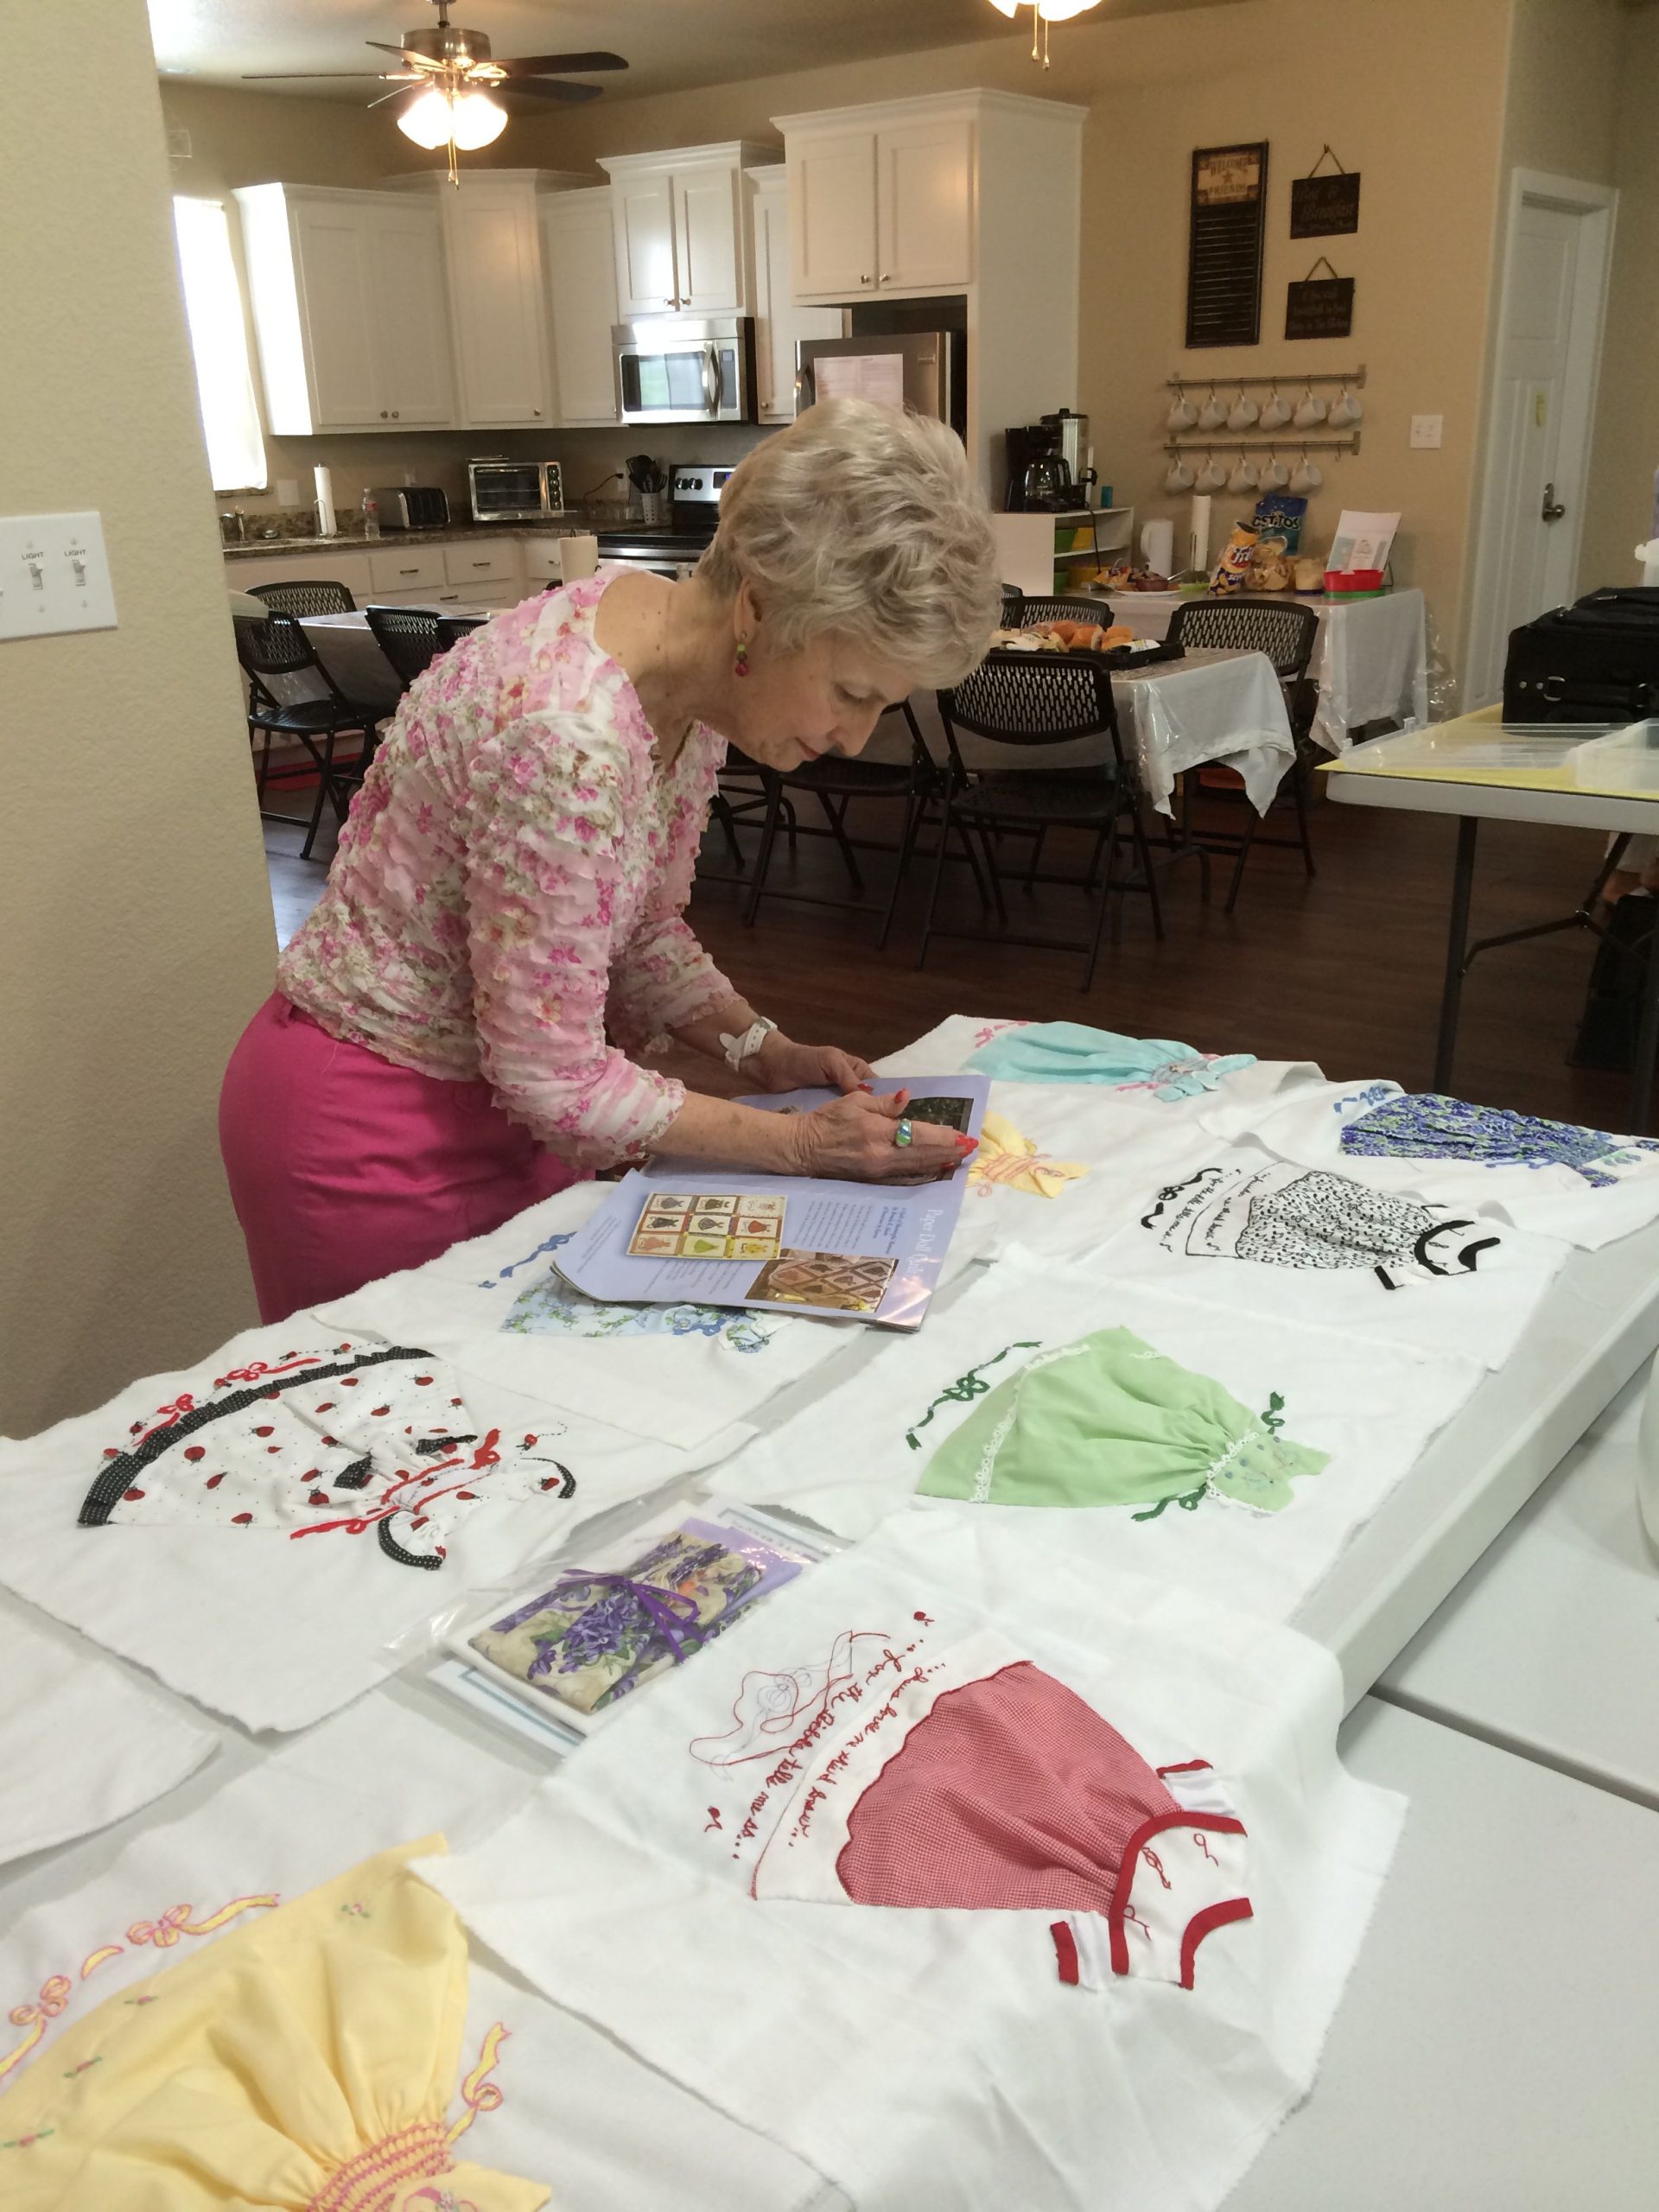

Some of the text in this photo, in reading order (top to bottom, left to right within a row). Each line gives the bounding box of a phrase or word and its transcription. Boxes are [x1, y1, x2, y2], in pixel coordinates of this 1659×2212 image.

[1210, 158, 1249, 178] WELCOME
[1209, 184, 1246, 197] FRIENDS
[22, 551, 44, 561] LIGHT
[64, 549, 86, 557] LIGHT
[918, 1209, 944, 1231] Paper
[916, 1234, 936, 1253] Doll
[830, 1682, 863, 1710] the
[864, 1702, 898, 1735] loves
[788, 1709, 836, 1758] Bible
[845, 1732, 864, 1748] me
[766, 1758, 804, 1789] tells
[750, 1791, 769, 1817] me
